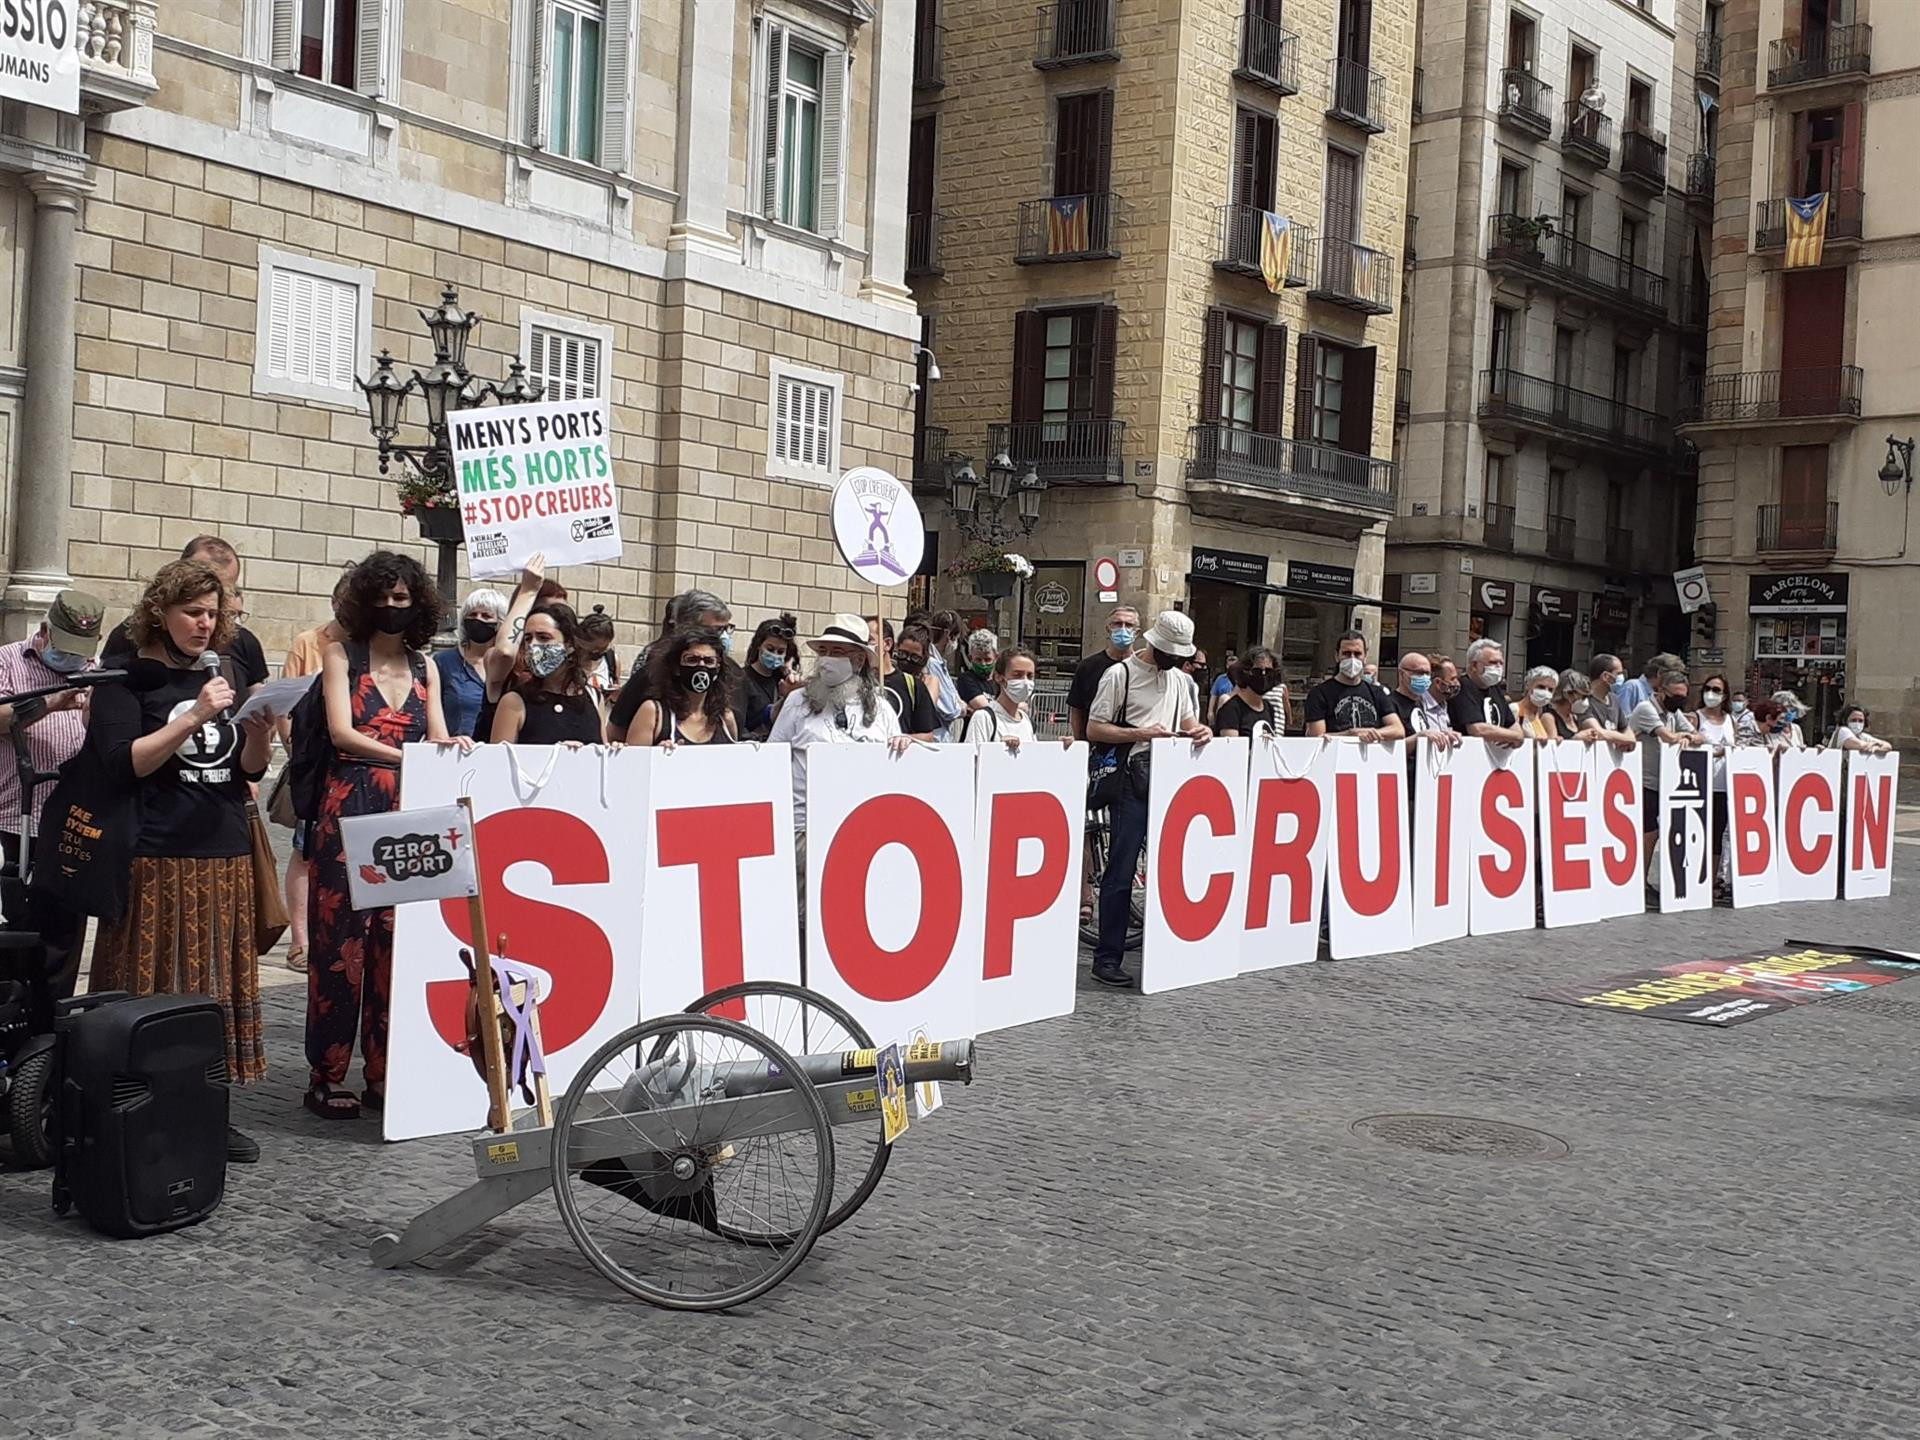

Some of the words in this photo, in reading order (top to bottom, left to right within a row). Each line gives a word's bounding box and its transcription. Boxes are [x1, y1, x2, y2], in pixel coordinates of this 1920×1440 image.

[455, 416, 532, 451] MENYS
[537, 410, 603, 442] PORTS
[462, 449, 517, 494] MÉS
[524, 444, 608, 486] HORTS
[464, 482, 613, 525] #STOPCREUERS
[1762, 576, 1836, 601] BARCELONA
[380, 840, 436, 861] ZERO
[394, 855, 447, 875] PORT
[1159, 770, 1638, 943] CRUISES
[1732, 772, 1892, 876] BCN
